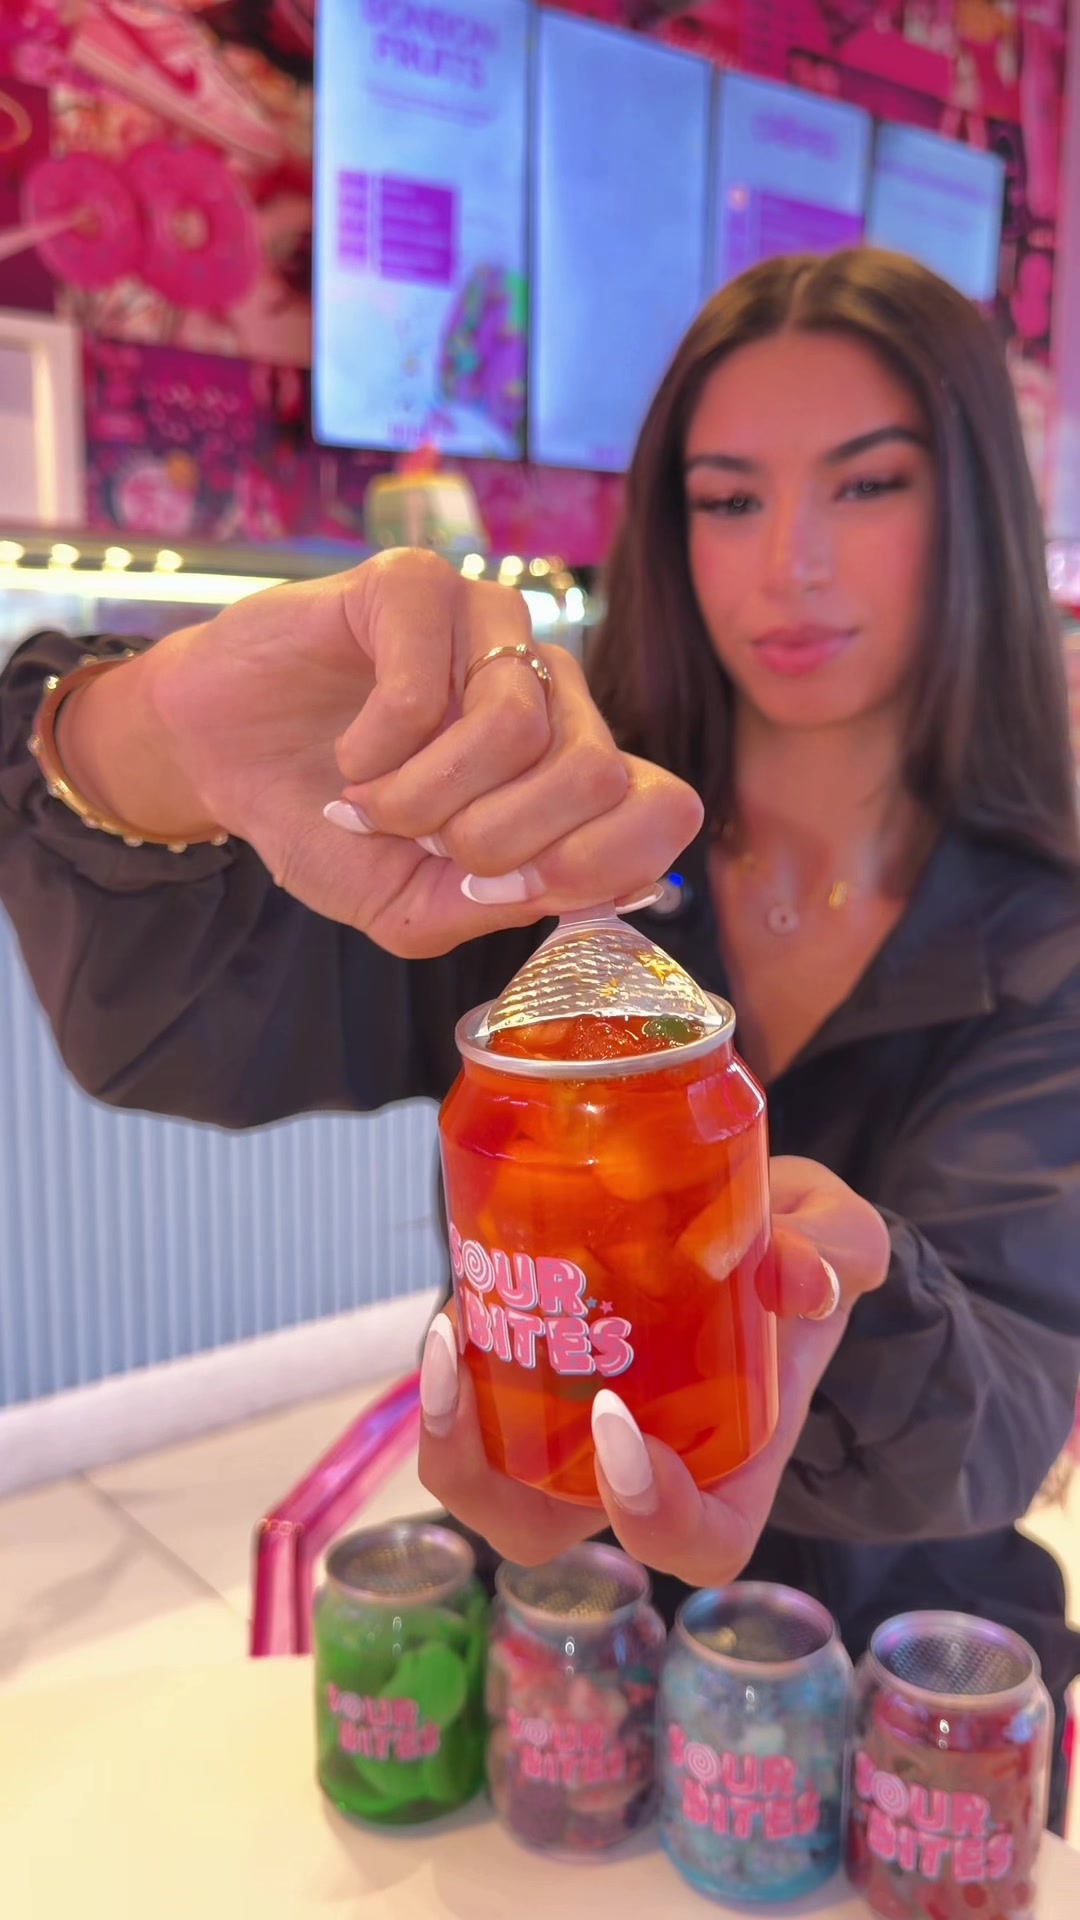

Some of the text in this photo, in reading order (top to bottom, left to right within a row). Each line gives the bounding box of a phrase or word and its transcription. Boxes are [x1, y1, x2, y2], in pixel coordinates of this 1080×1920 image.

[450, 1221, 588, 1318] SOUR
[460, 1287, 634, 1377] BITES
[340, 1723, 440, 1761] BITES
[521, 1746, 625, 1783] BITES
[668, 1724, 797, 1797] SOUR
[682, 1780, 821, 1840] BITES
[856, 1752, 991, 1836] SOUR
[868, 1808, 1013, 1882] BITES
